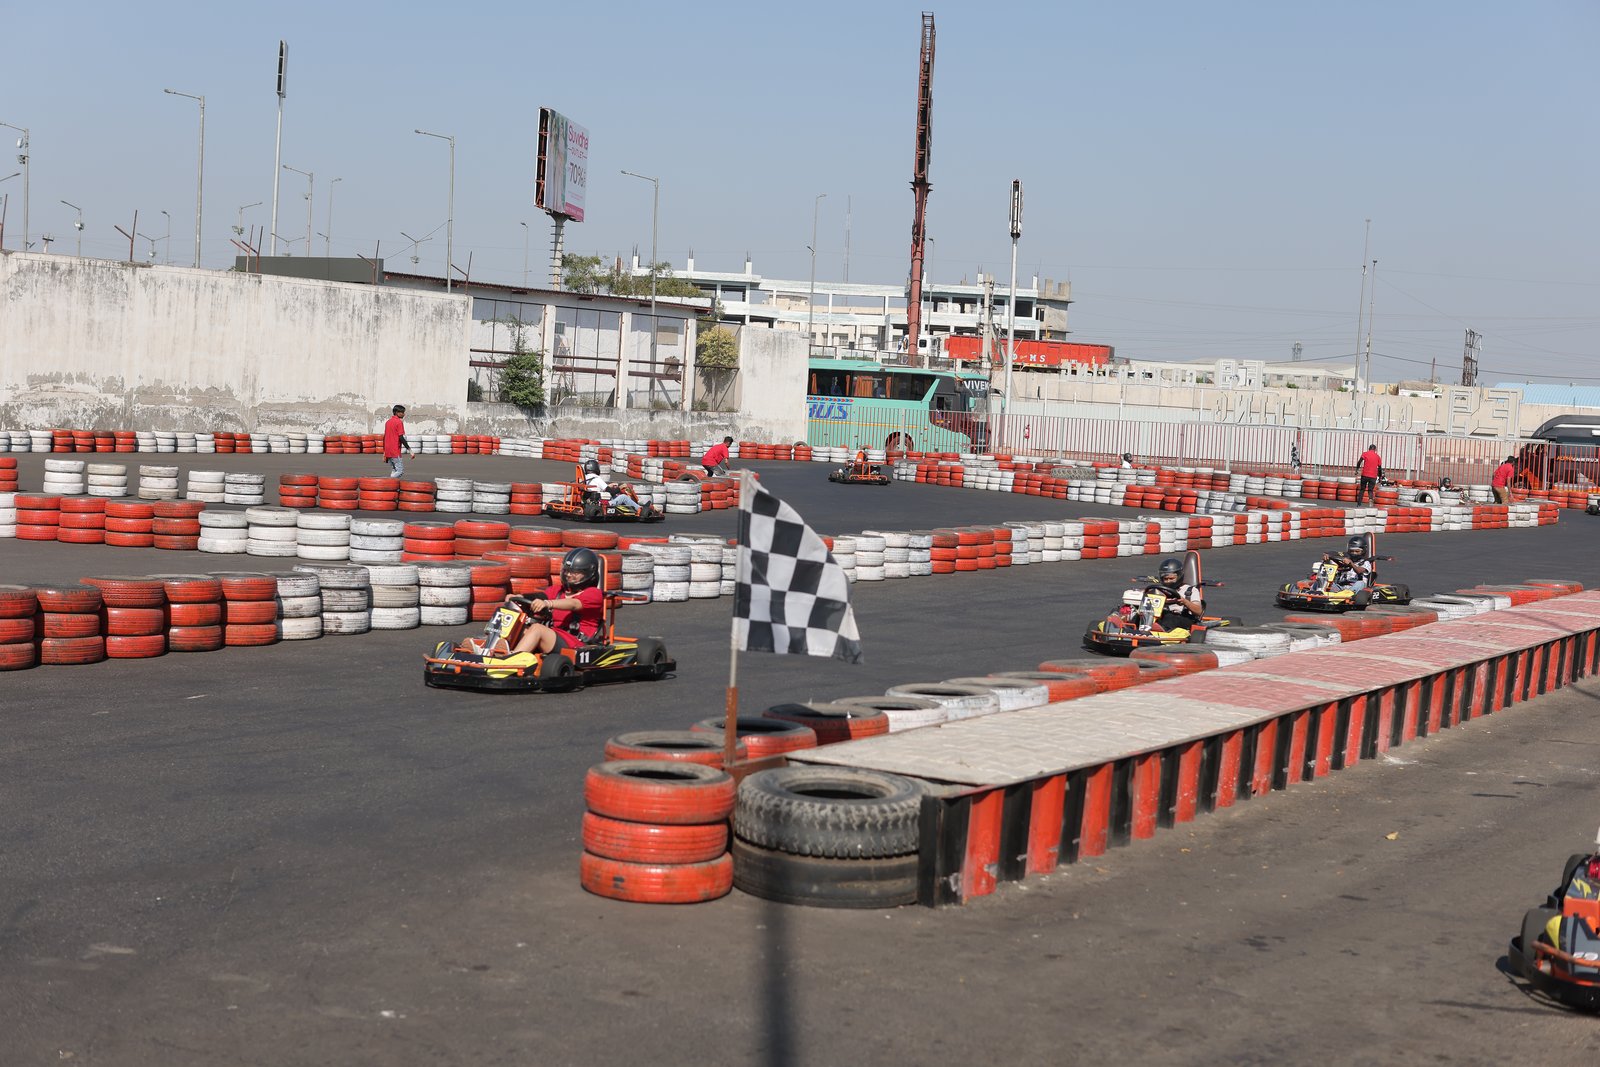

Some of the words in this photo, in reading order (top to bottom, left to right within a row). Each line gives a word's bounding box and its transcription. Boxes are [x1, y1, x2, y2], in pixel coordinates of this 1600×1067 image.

[1143, 596, 1161, 609] F9
[491, 611, 514, 628] F9
[579, 651, 590, 664] 11
